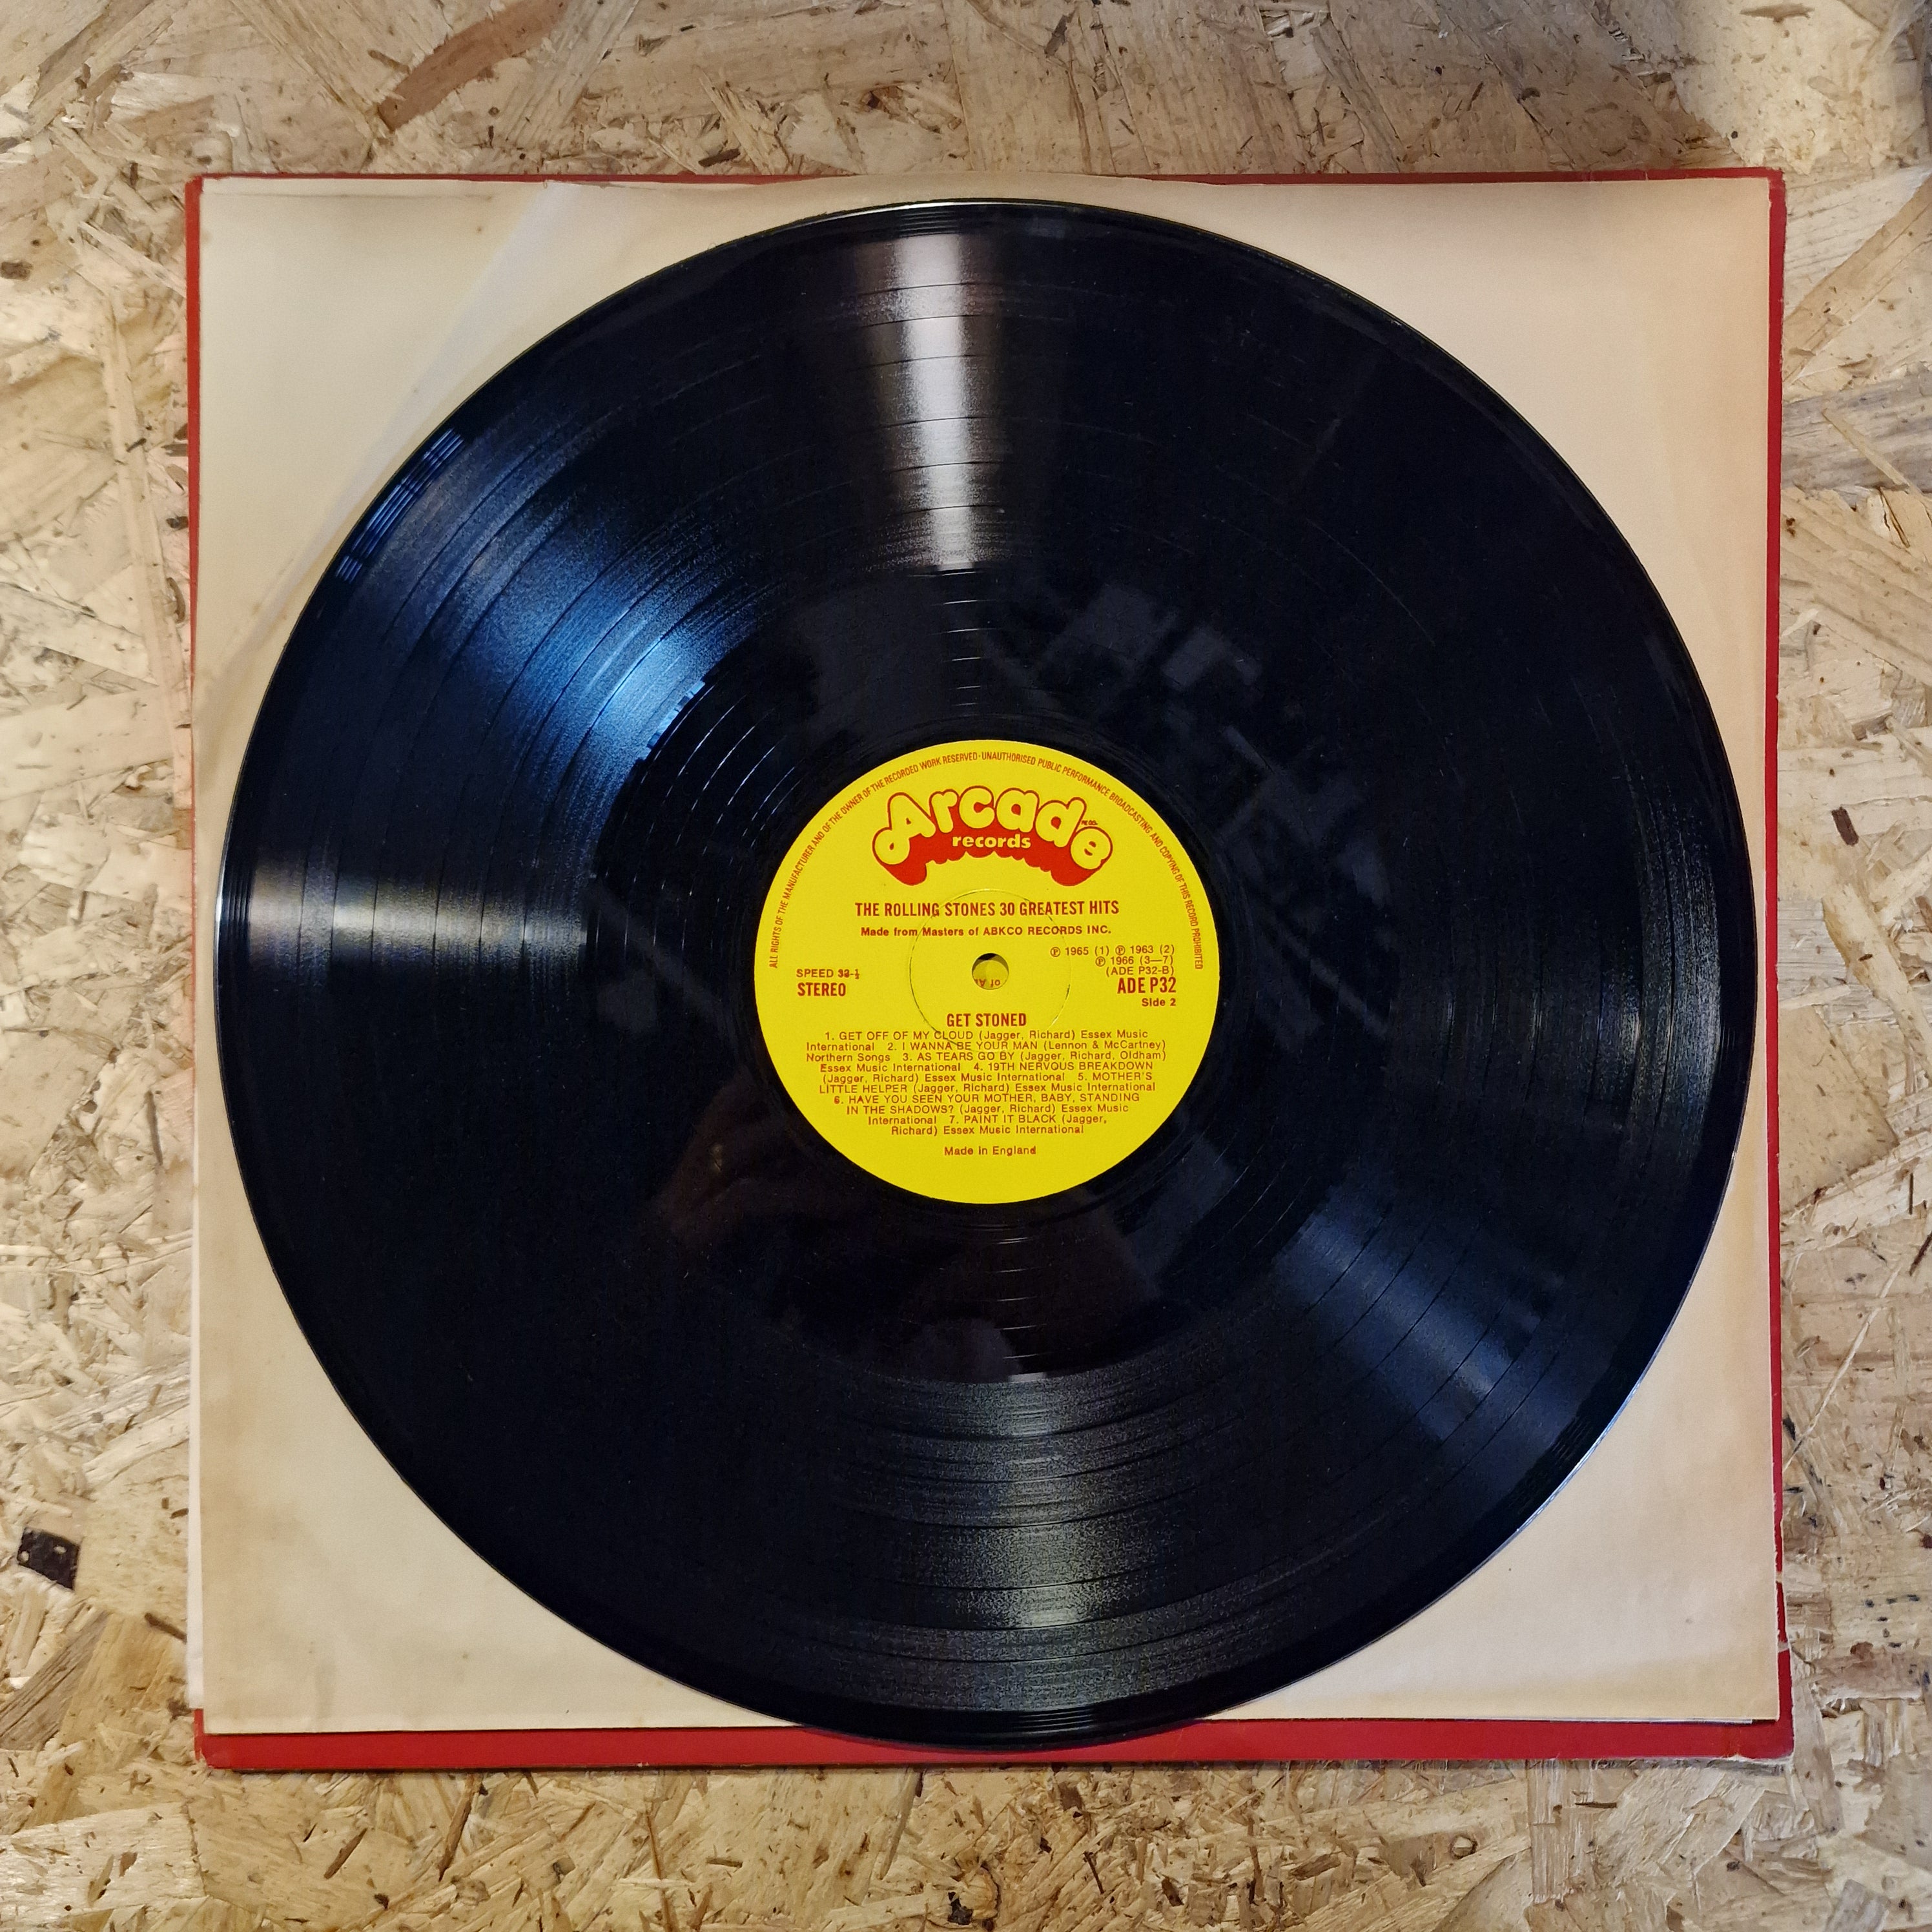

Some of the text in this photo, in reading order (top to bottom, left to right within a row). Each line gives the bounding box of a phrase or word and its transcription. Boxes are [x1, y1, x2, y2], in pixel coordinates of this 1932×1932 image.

[919, 757, 941, 770] WORK
[1037, 757, 1062, 772] PUBLIC
[883, 764, 918, 785] RECORDED
[1062, 766, 1110, 796] PERFORMANCE
[862, 786, 870, 797] OF
[869, 779, 885, 792] THE
[839, 793, 864, 814] OWNER
[828, 811, 843, 825] THE
[1108, 792, 1153, 833] BROADCASTING
[821, 821, 831, 832] OF
[872, 786, 1113, 872] Arcade
[811, 830, 825, 847] AND
[952, 833, 1031, 850] records
[1149, 832, 1163, 847] AND
[1159, 846, 1180, 874] COPYING
[782, 844, 815, 899] MANUFACTURER
[1174, 873, 1184, 882] OF
[1178, 882, 1191, 899] THIS
[777, 900, 788, 914] THE
[854, 899, 1119, 917] THE ROLLING STONES 30 GREATEST HITS
[1184, 899, 1198, 926] RECORD
[774, 915, 783, 925] OF
[860, 925, 1111, 936] Made from Masters of ABKCO RECORDS INC.
[770, 926, 781, 952] RIGHTS
[1065, 946, 1089, 956] 1965
[1094, 945, 1109, 958] (1)
[1129, 945, 1153, 954] 1963
[1160, 944, 1174, 956] (2)
[1191, 927, 1203, 969] PROHIBITED
[768, 955, 777, 968] ALL
[1110, 956, 1134, 965] 1966
[796, 968, 834, 978] SPEED
[1105, 966, 1174, 978] (ADE P32-B)
[797, 981, 846, 996] STEREO
[1116, 976, 1176, 994] ADE P32
[1141, 997, 1176, 1007] Side 2
[946, 1012, 1027, 1027] GET STONED
[825, 1029, 1147, 1041] 1. GET OFF OF MY CLOUD (Jagger, Richard) Essex Music
[807, 1040, 1165, 1051] International 2. I WANNA BE YOUR MAN (Lennon & McCartney)
[806, 1050, 1166, 1063] Northern Songs 3. AS TEARS GO BY (Jagger, Richard, Oldham)
[820, 1061, 1153, 1072] Essex Music International 4. 19TH NERVOUS BREAKDOWN
[823, 1071, 1152, 1084] (Jagger, Richard) Essex Music International 5. MOTHER'S
[819, 1082, 1155, 1094] LITTLE HELPER (Jagger, Richard) Essex Music International
[848, 1094, 879, 1104] HAVE
[883, 1094, 907, 1103] YOU
[912, 1094, 941, 1103] SEEN
[947, 1093, 979, 1103] YOUR
[984, 1093, 1036, 1102] MOTHER,
[1041, 1093, 1074, 1102] BABY,
[1080, 1092, 1139, 1102] STANDING
[847, 1103, 1128, 1115] IN THE SHADOWS? (Jagger, Richard) Essex Music
[868, 1114, 1106, 1125] International 7. PAINT IT BLACK (Jagger,
[891, 1124, 1084, 1136] Richard) Essex Music International
[944, 1146, 1036, 1156] Made in England
